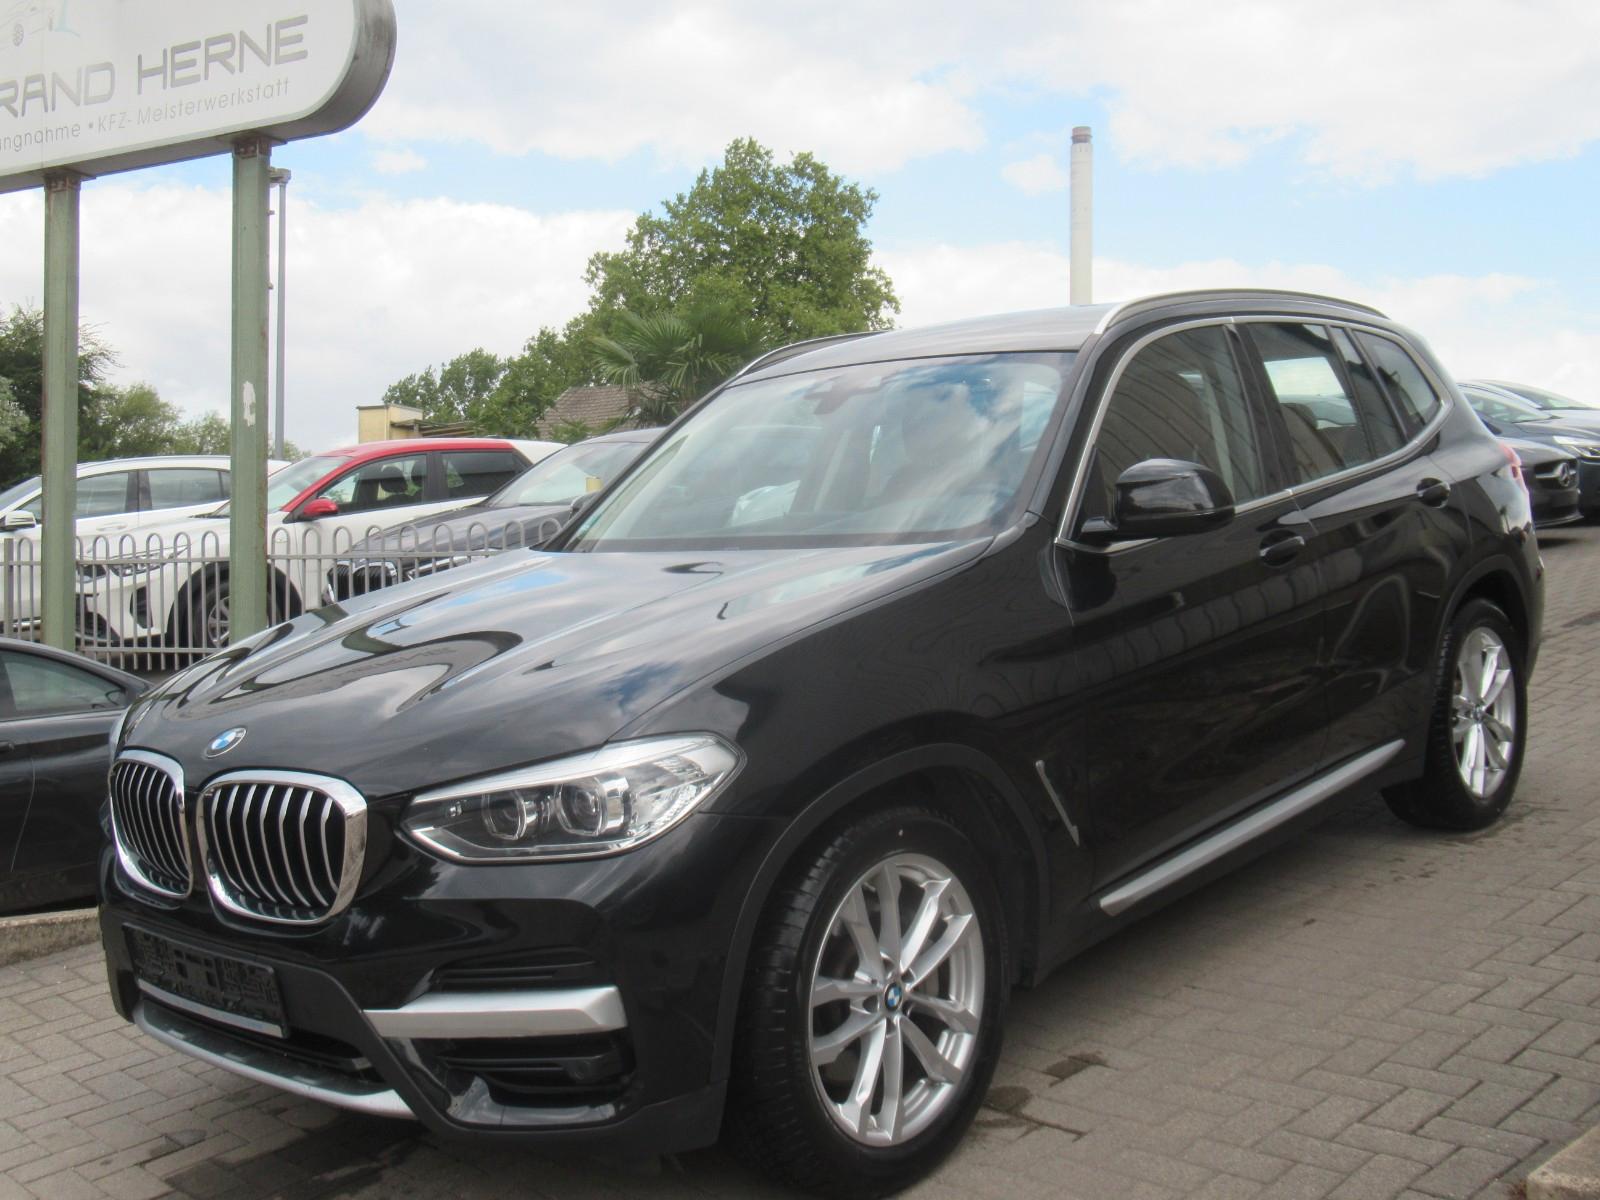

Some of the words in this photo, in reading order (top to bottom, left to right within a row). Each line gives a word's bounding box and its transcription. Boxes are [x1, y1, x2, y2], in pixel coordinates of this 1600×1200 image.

[137, 14, 309, 95] HERNE
[0, 122, 82, 152] ngnahme
[137, 77, 291, 125] Meisterwerkstatt
